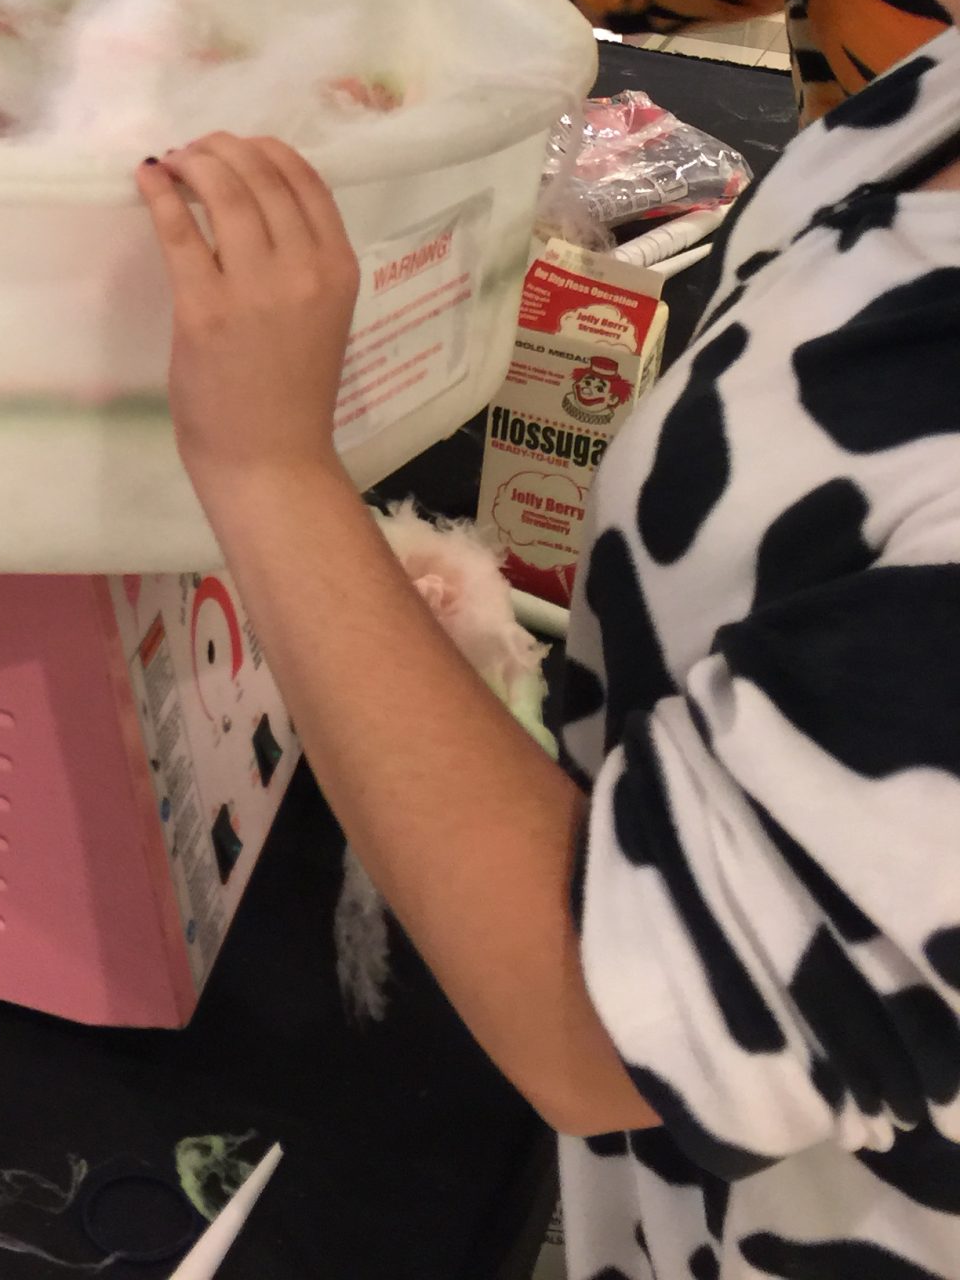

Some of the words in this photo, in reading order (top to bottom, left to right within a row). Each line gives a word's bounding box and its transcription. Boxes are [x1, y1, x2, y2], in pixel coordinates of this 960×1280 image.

[590, 286, 639, 309] Operation
[576, 312, 600, 326] Jolly
[601, 318, 629, 333] Berry
[515, 340, 545, 353] GOLD
[548, 348, 589, 364] MEDAL
[491, 406, 608, 467] flossuga
[491, 439, 570, 469] READY-TO-USE
[511, 488, 543, 509] Jolly
[545, 497, 585, 521] Berry
